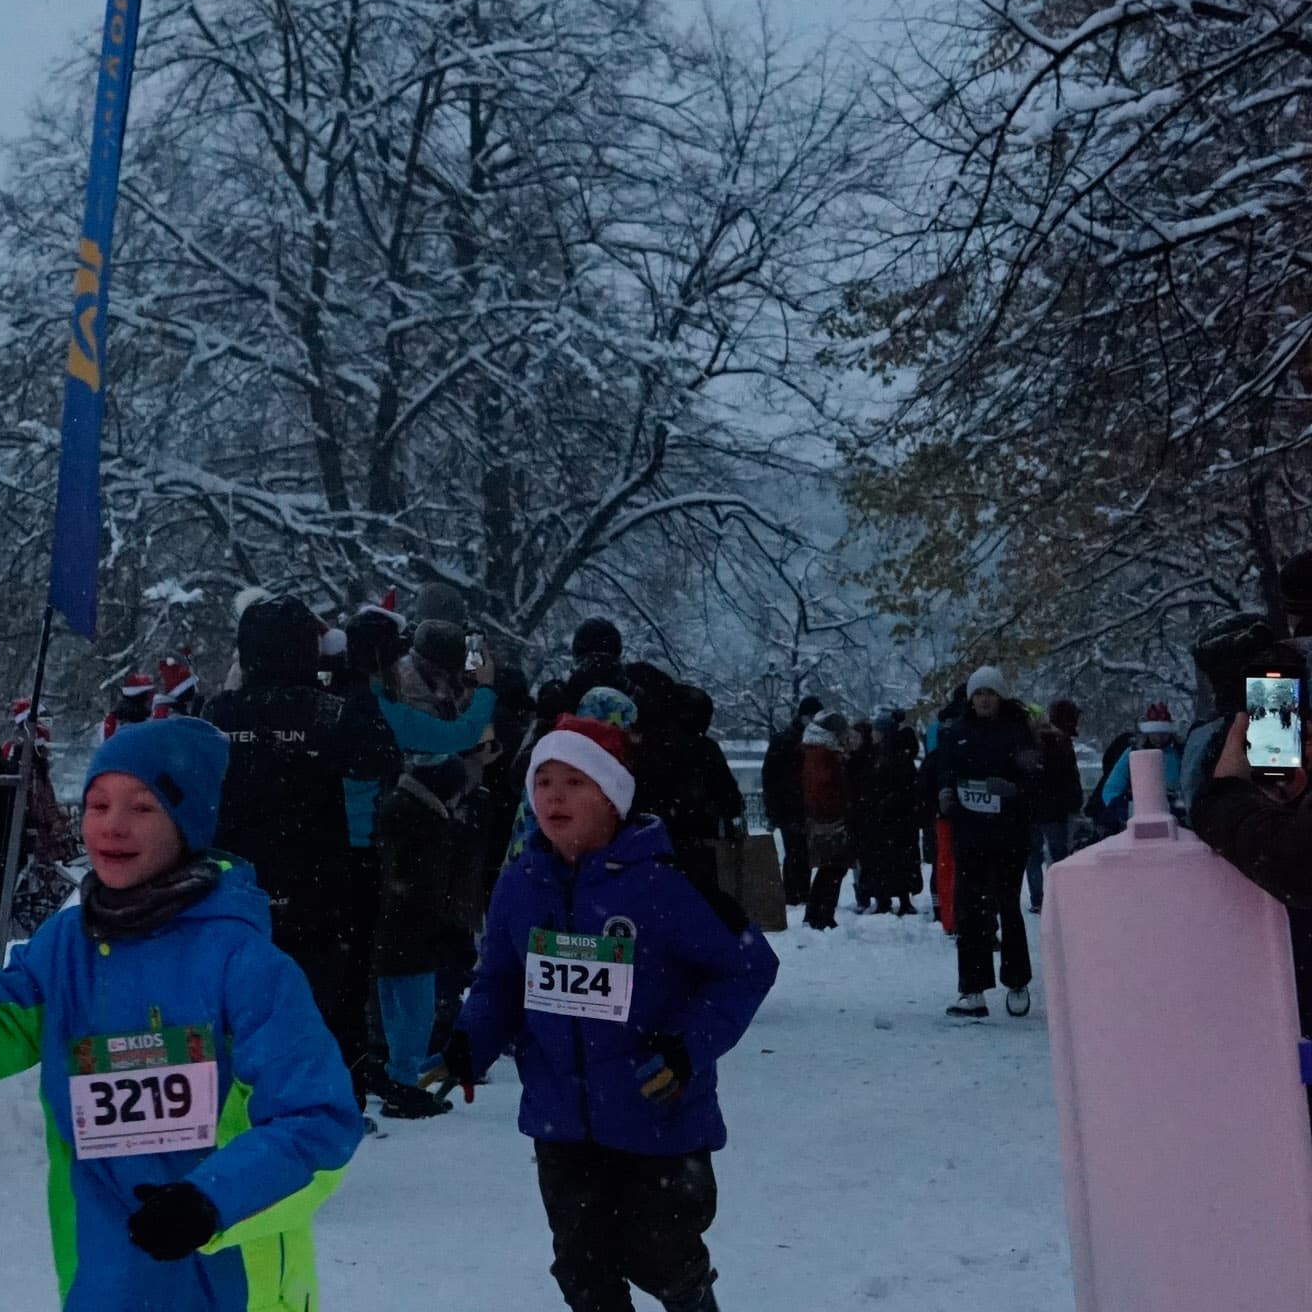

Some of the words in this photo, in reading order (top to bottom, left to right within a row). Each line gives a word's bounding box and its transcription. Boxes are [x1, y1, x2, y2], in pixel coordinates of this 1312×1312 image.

[571, 936, 597, 949] KIDS
[539, 960, 612, 997] 3124
[128, 1032, 165, 1049] KIDS
[90, 1073, 192, 1126] 3219
